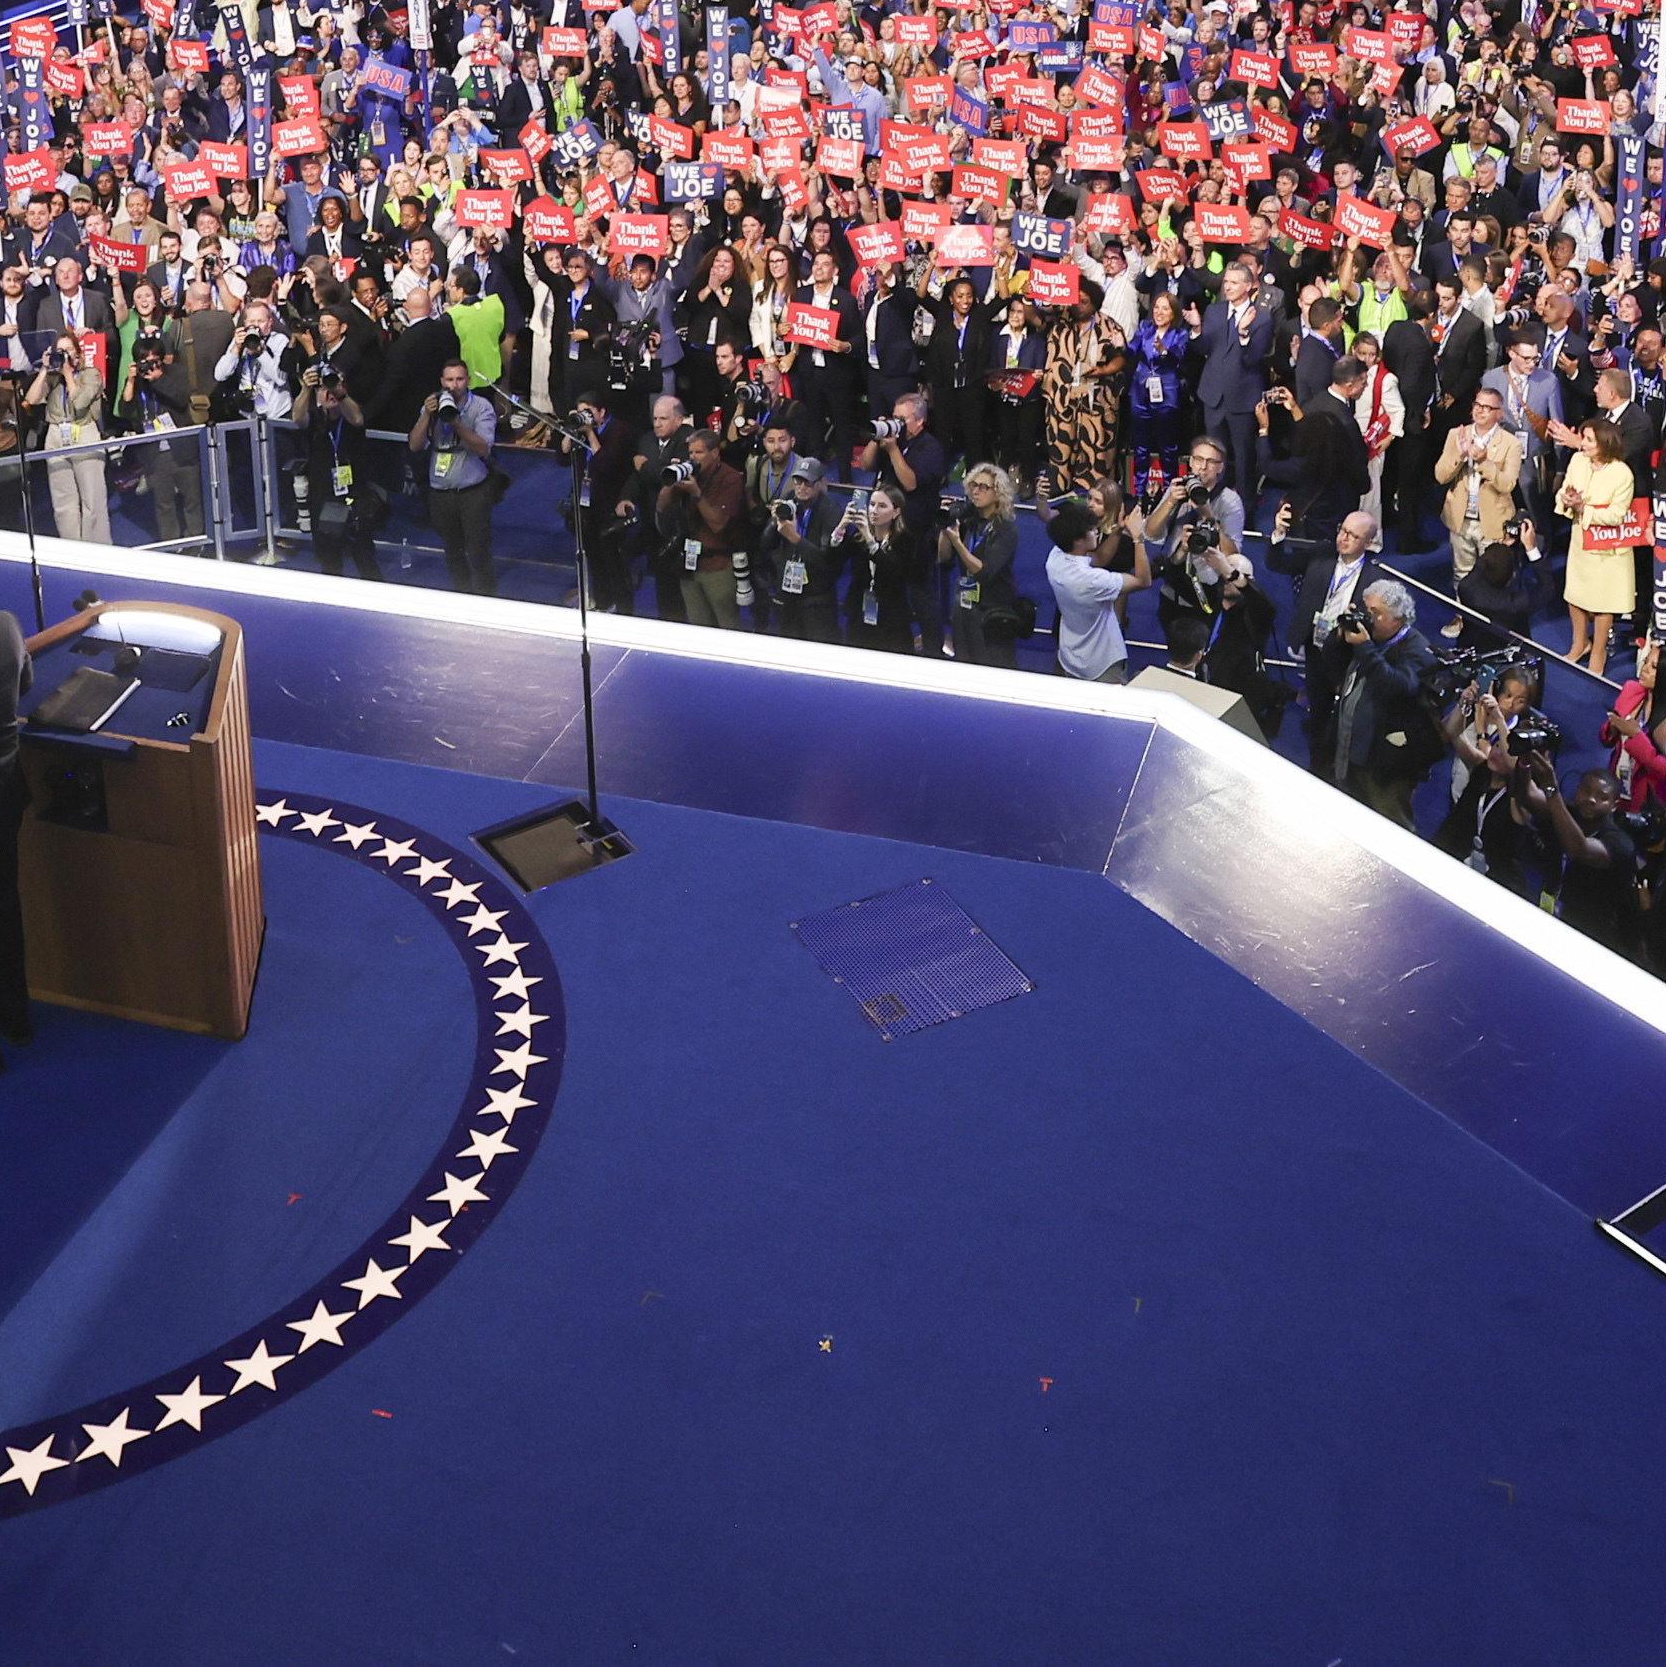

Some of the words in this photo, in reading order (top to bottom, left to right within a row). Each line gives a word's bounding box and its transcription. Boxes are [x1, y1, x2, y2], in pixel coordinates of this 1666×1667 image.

[365, 64, 406, 95] USA
[669, 164, 701, 181] WE
[671, 178, 716, 199] JOE
[618, 220, 658, 239] Thank
[1018, 215, 1049, 233] WE
[616, 233, 641, 250] You
[638, 232, 661, 251] Joe
[1017, 230, 1063, 255] JOE
